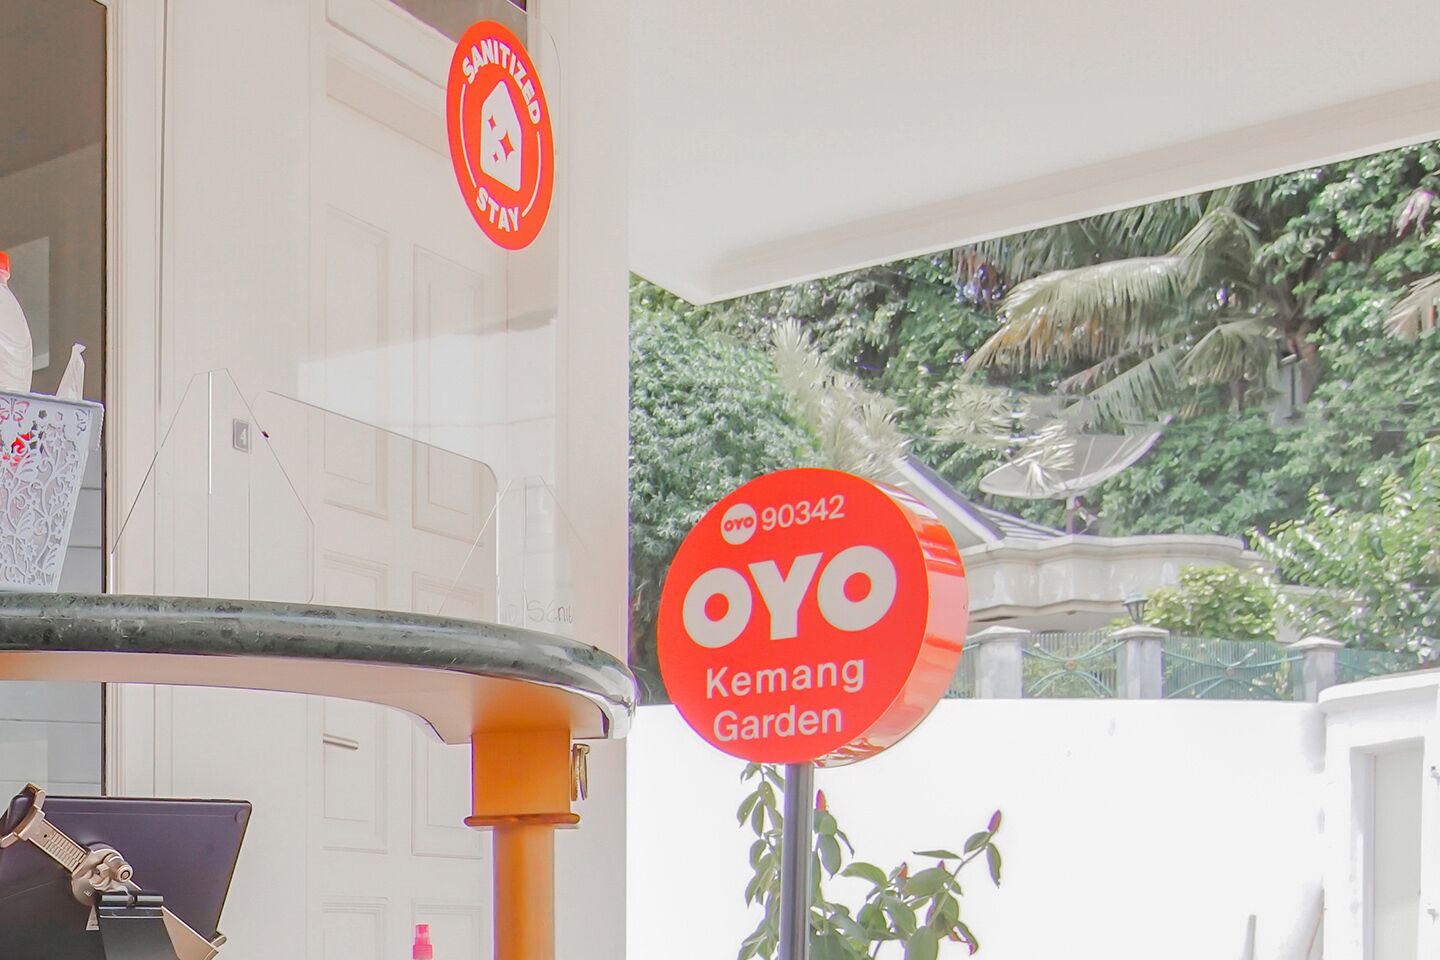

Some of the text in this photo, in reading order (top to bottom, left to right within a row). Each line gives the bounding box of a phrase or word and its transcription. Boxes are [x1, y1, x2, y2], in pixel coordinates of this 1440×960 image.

[462, 38, 541, 125] SANITIZED
[476, 186, 519, 232] STAY
[724, 494, 845, 532] OYO 90342
[682, 545, 898, 649] OYO
[706, 658, 865, 699] Kemang
[713, 704, 842, 742] Garden
